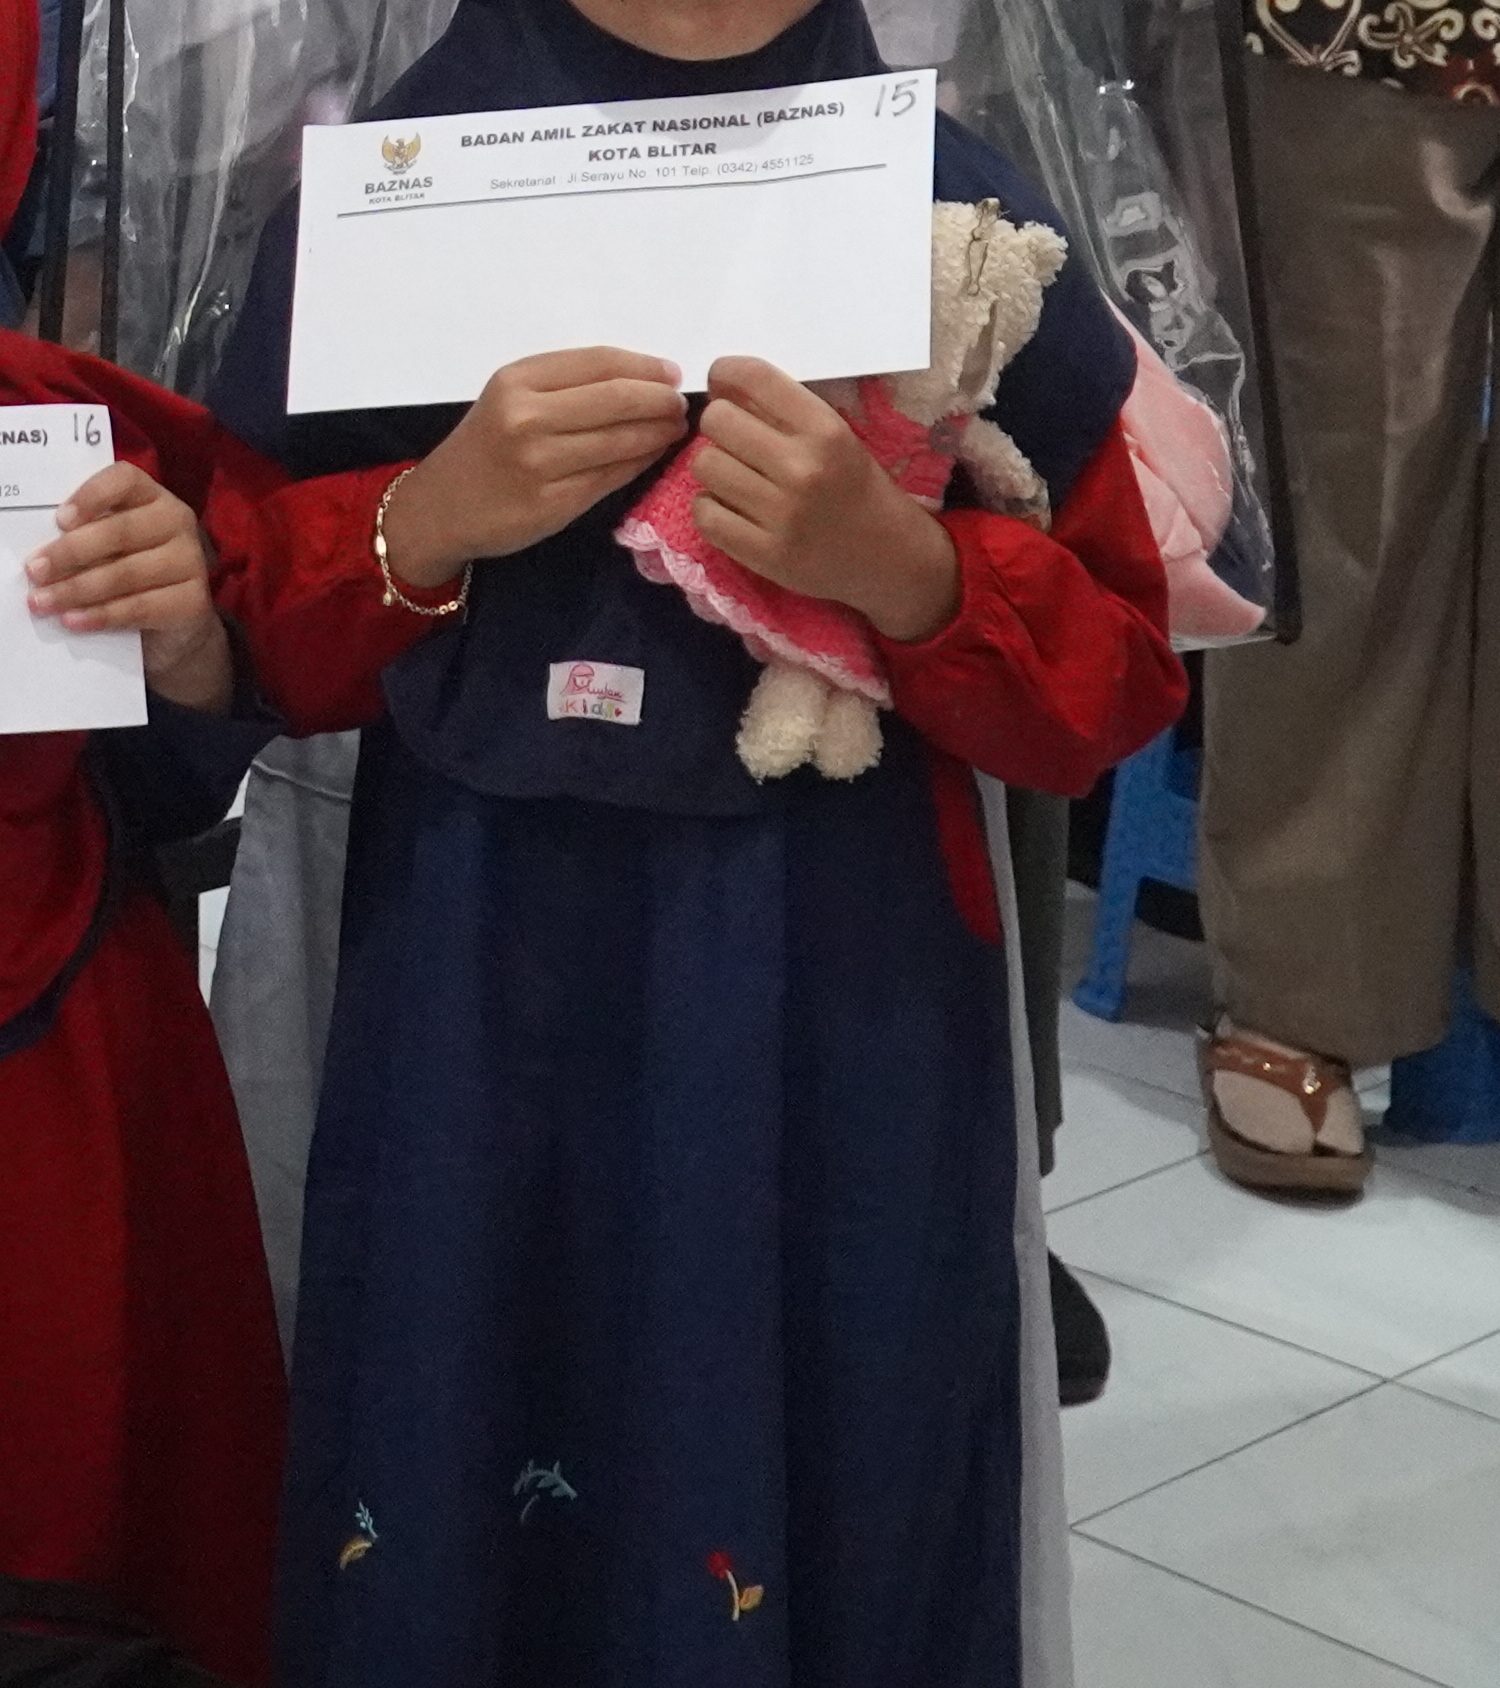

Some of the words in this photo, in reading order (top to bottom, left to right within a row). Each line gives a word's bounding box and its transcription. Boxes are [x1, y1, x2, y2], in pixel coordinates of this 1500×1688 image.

[873, 78, 920, 118] 15
[461, 131, 525, 148] BADAN
[530, 127, 576, 143] AMIL
[582, 121, 647, 138] ZAKAT
[652, 114, 751, 133] NASIONAL
[757, 102, 845, 128] (BAZNAS)
[588, 147, 642, 162] KOTA
[647, 142, 717, 158] BLITAR
[364, 176, 434, 195] BAZNAS
[490, 174, 556, 190] Sekretariat
[656, 166, 677, 178] 101
[717, 161, 759, 176] (0342)
[762, 154, 815, 171] 4551125
[368, 196, 392, 205] KOTA
[73, 413, 102, 446] 16
